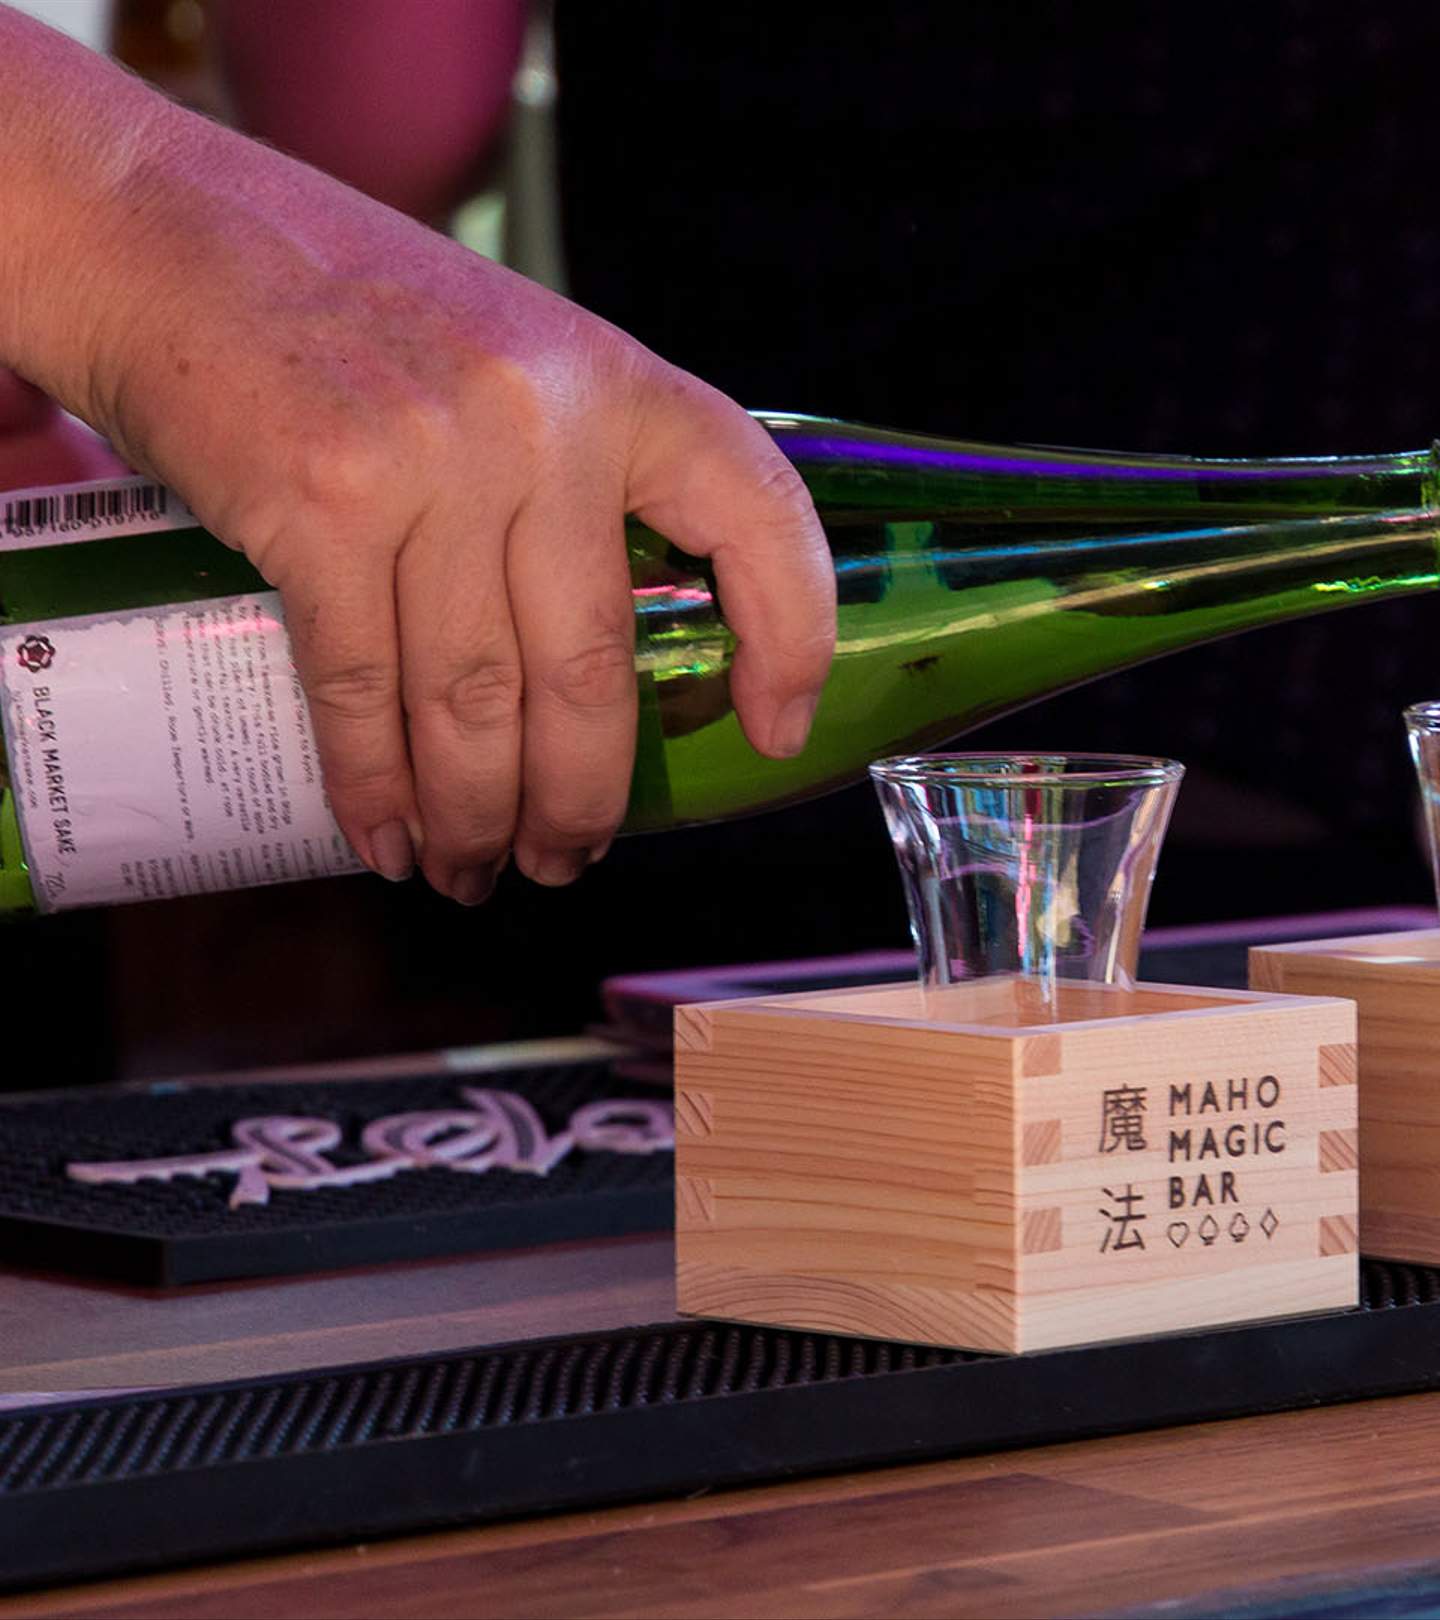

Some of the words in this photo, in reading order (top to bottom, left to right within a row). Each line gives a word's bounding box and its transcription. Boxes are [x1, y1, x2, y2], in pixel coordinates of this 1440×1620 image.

[32, 685, 57, 742] BLACK
[42, 747, 67, 815] MARKET
[54, 818, 75, 857] SAKE
[1168, 1074, 1281, 1117] MAHO
[1168, 1119, 1287, 1163] MAGIC
[1168, 1170, 1240, 1210] BAR
